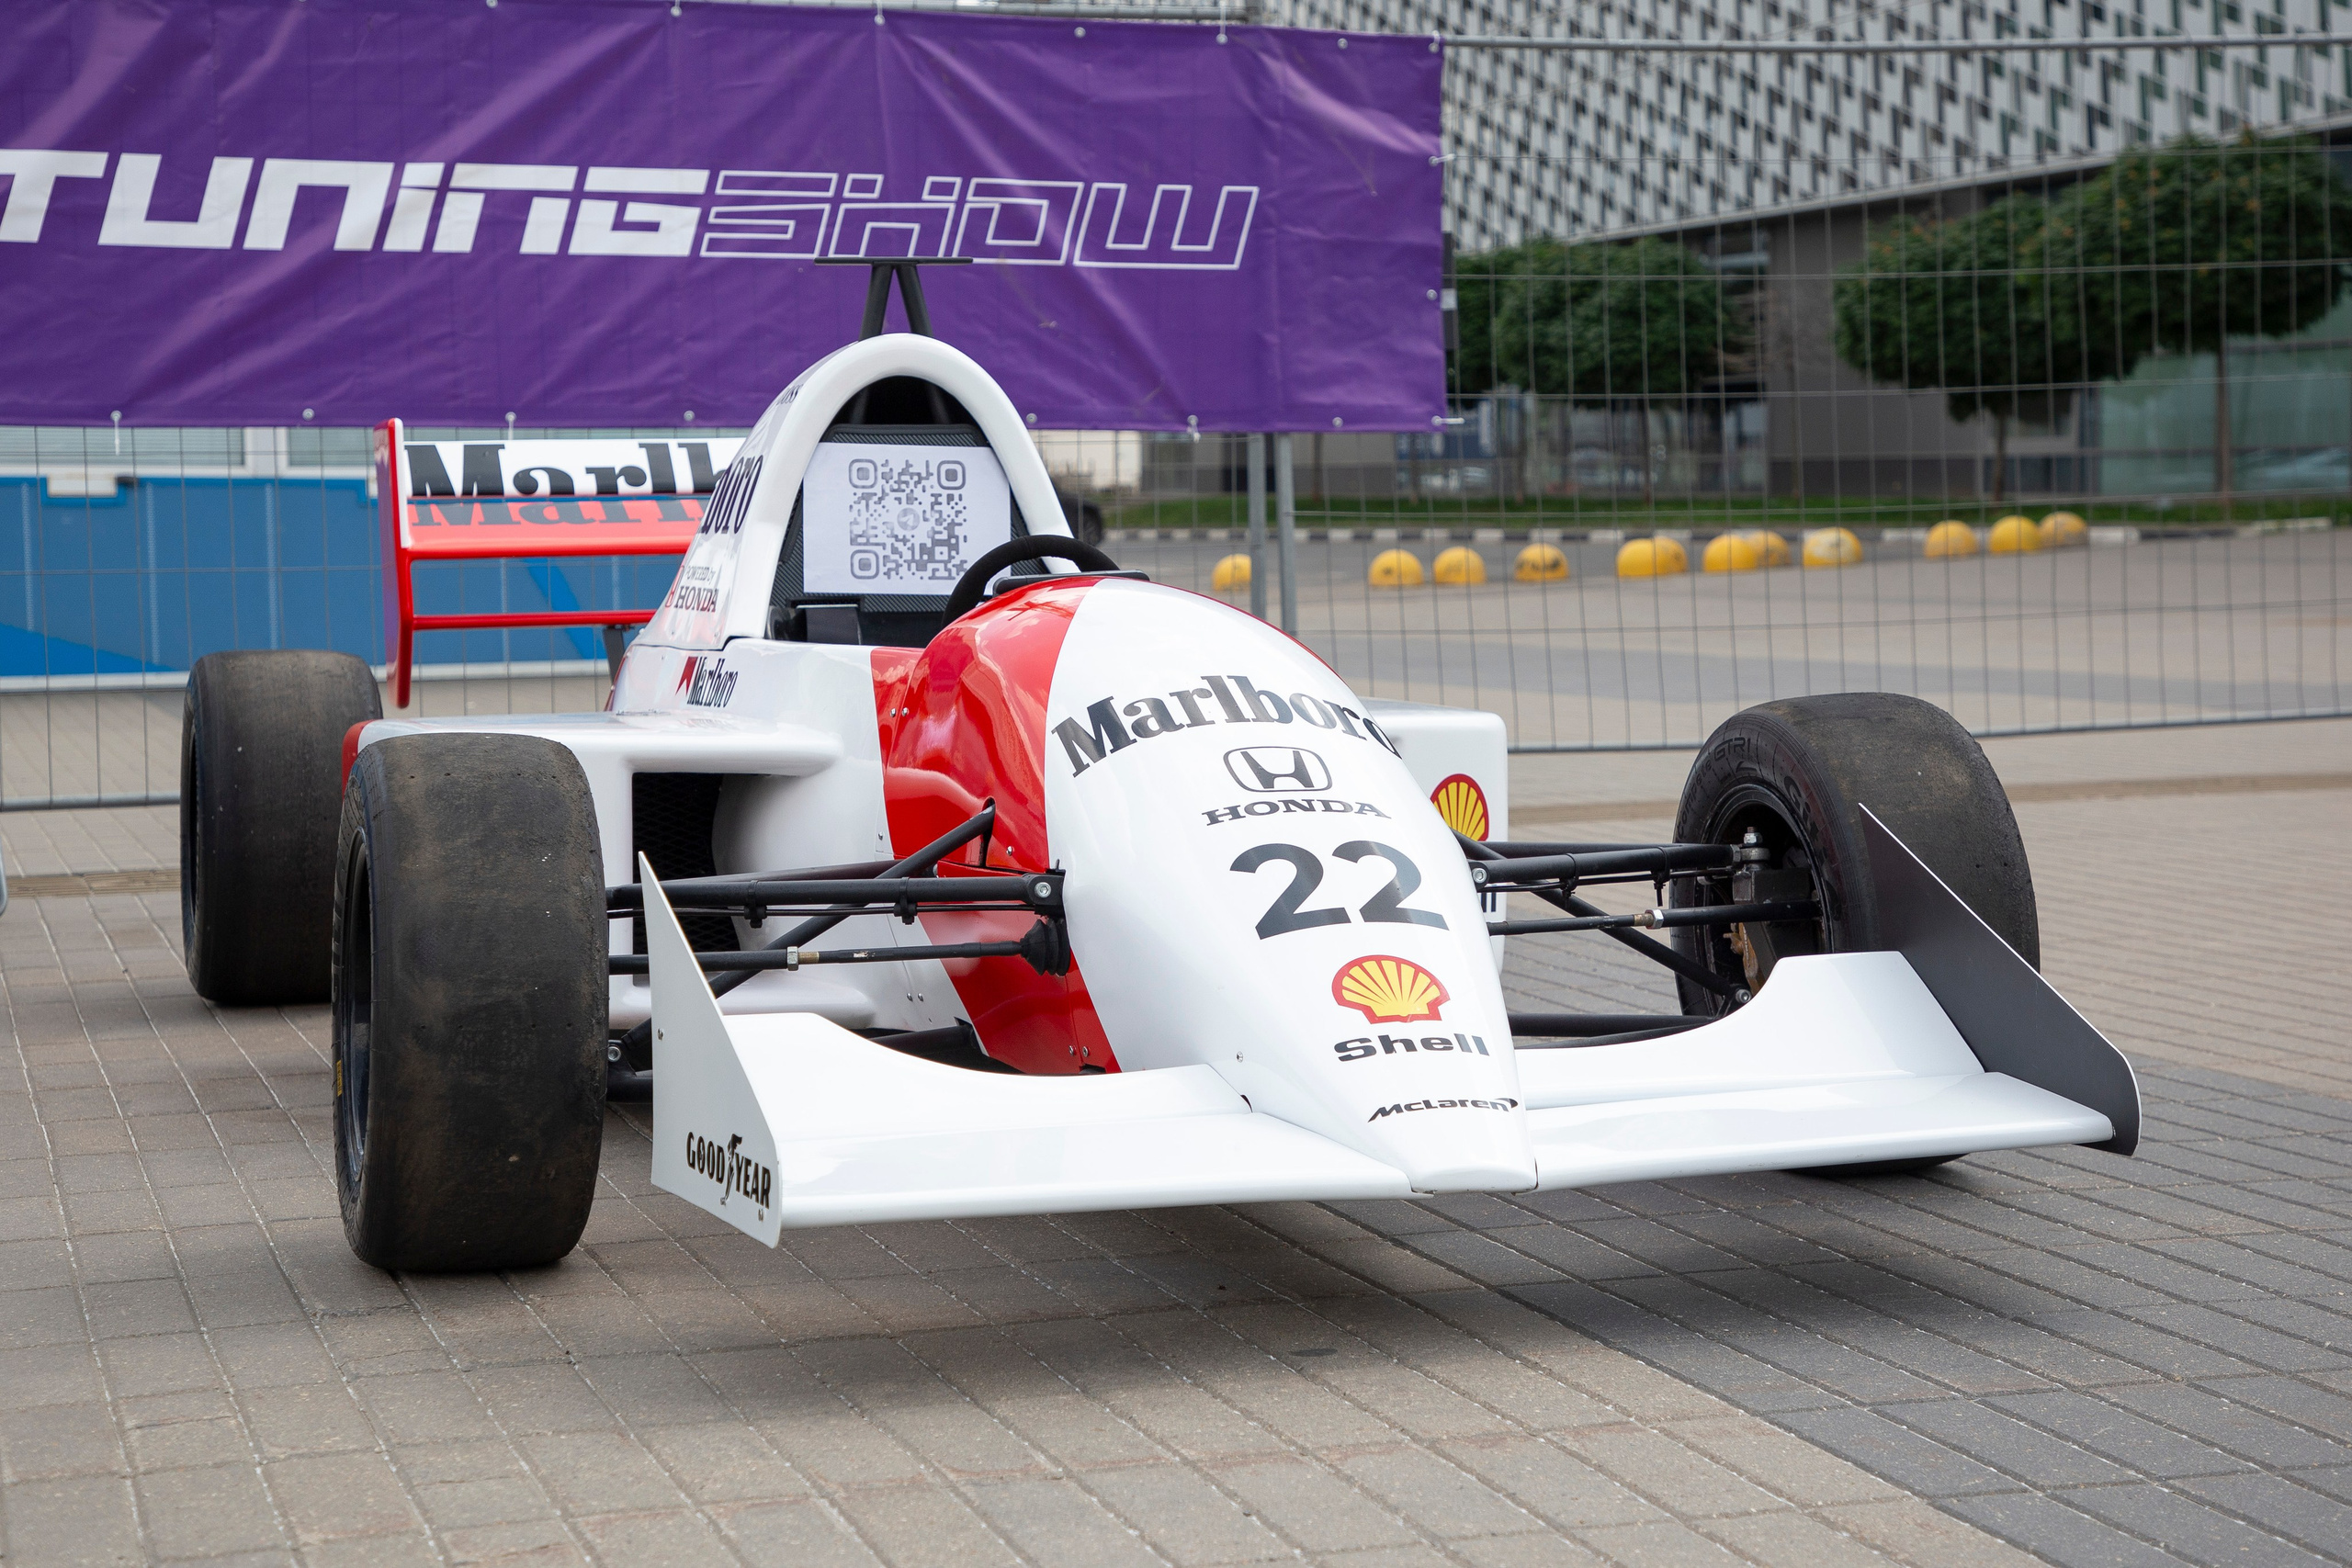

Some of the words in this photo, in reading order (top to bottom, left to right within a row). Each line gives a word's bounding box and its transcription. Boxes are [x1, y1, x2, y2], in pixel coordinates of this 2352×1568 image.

[673, 586, 719, 613] HONDA
[686, 656, 738, 707] Marlboro
[1051, 675, 1403, 778] Marlboro
[1201, 798, 1392, 826] HONDA
[1228, 840, 1450, 941] 22
[1333, 1032, 1490, 1062] Shell
[1367, 1098, 1519, 1123] McLaren
